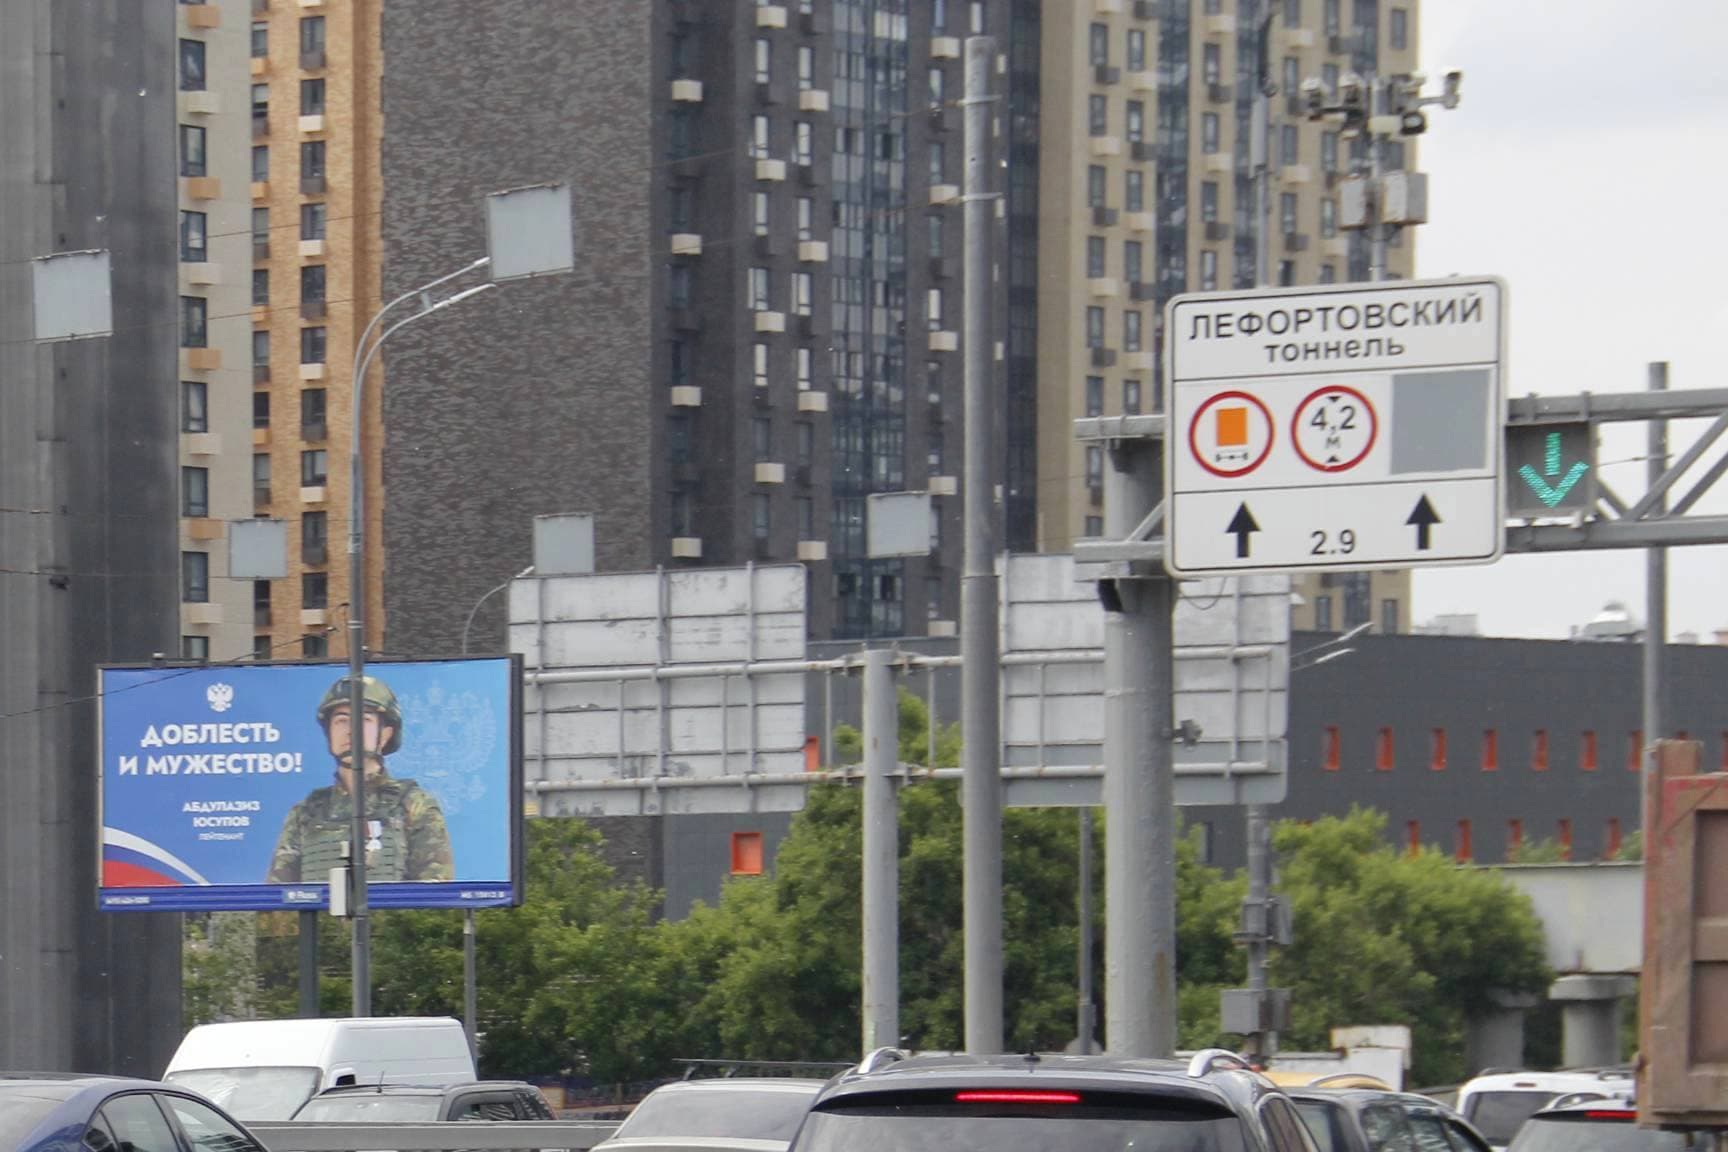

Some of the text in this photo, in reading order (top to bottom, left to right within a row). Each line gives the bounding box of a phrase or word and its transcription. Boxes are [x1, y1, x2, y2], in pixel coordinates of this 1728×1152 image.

[1189, 294, 1482, 340] ЛЕФОРТОВСКИЙ
[1263, 337, 1405, 363] тоннель
[1310, 405, 1357, 435] 4,2
[1310, 529, 1356, 554] 2.9
[140, 722, 281, 748] ДОБЛЕСТЬ
[119, 752, 303, 775] И МУЖЕСТВО!
[192, 815, 250, 828] ЮСУПОВ
